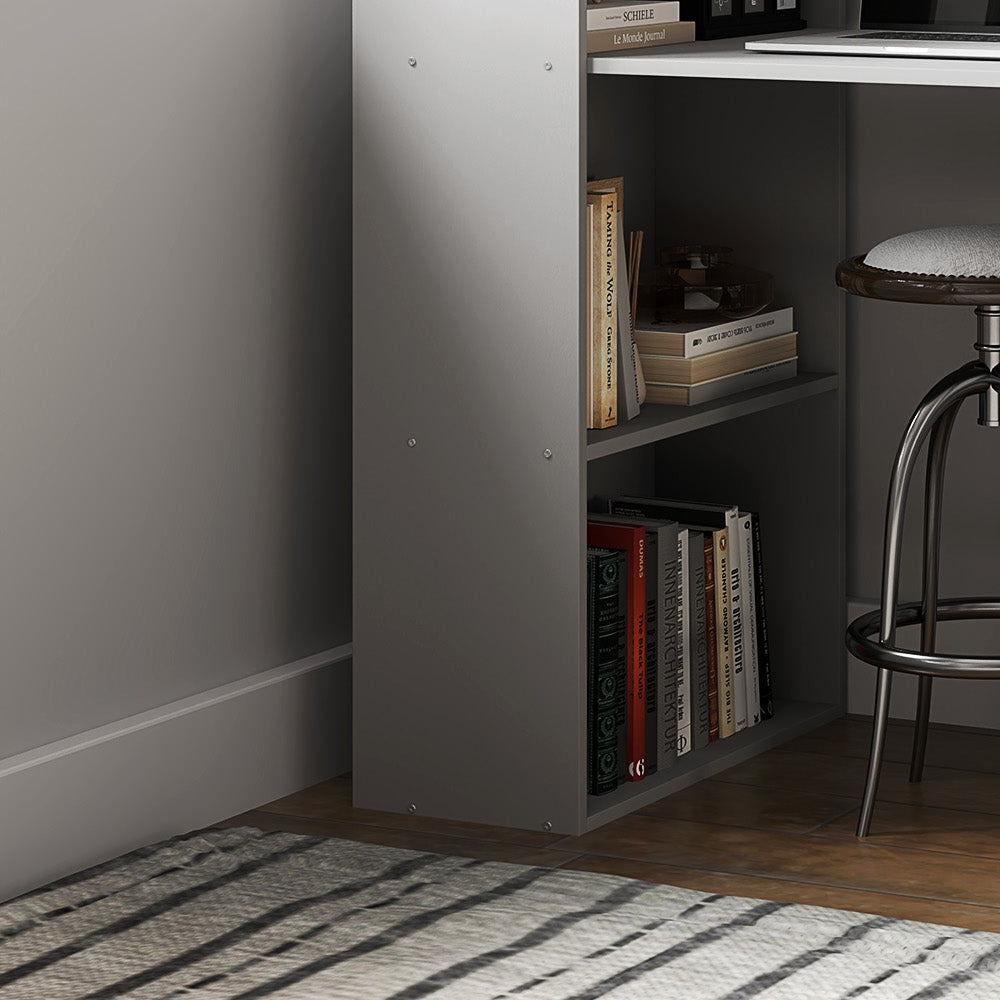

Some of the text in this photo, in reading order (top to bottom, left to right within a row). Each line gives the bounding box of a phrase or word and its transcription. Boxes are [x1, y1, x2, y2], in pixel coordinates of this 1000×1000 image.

[613, 29, 666, 45] Le Monde Journal
[623, 9, 654, 22] SCHIELE
[731, 568, 739, 590] arts
[664, 560, 678, 752] INNENARCHITEKTUR
[696, 566, 708, 734] INNENARCHITEKTUR
[733, 607, 743, 674] architecture
